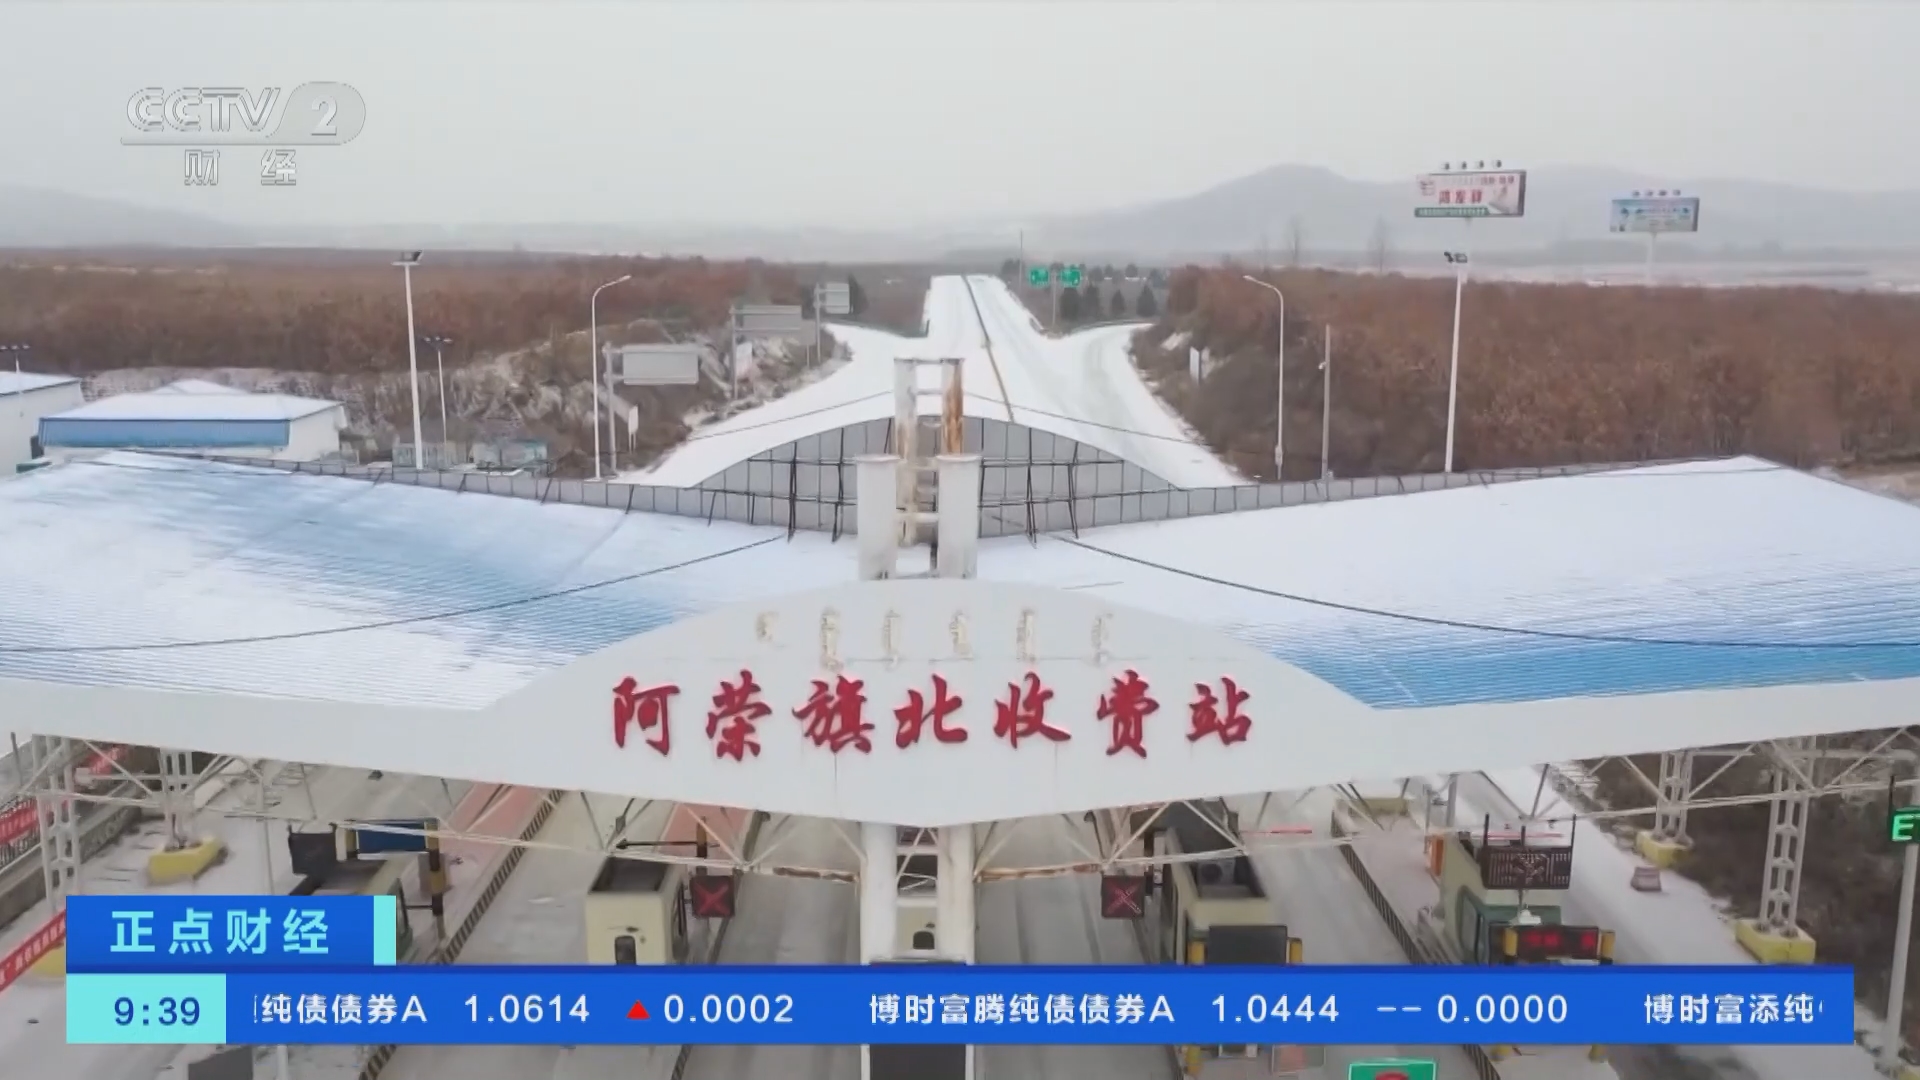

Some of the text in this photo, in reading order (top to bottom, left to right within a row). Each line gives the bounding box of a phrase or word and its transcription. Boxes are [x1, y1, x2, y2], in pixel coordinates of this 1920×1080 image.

[613, 671, 1252, 758] 阿荣旗北收费站
[1892, 813, 1920, 841] E
